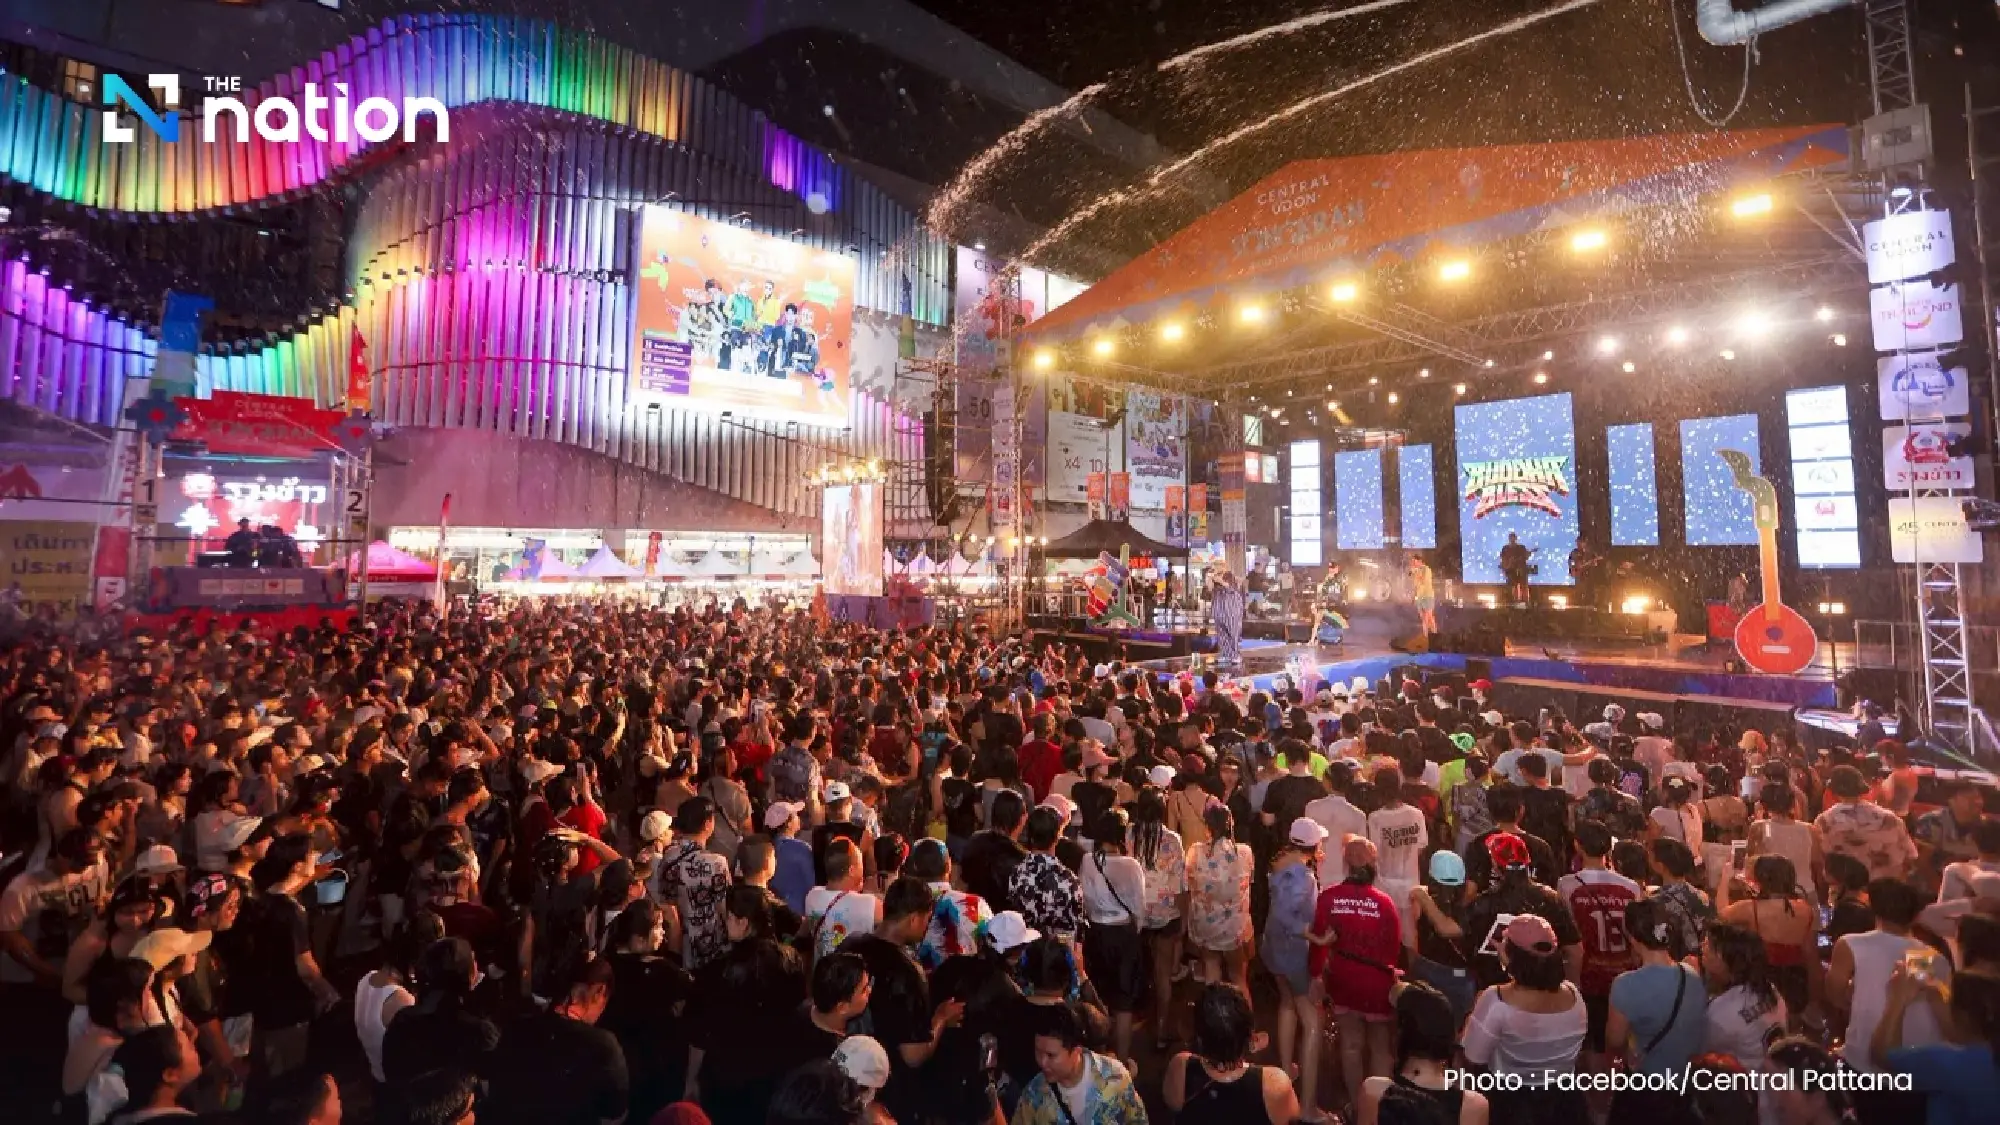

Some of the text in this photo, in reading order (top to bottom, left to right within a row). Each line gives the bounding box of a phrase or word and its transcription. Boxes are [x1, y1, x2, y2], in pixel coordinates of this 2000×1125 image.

[1257, 174, 1330, 205] CENTRAL
[1271, 192, 1316, 215] UDON
[142, 480, 156, 503] 1
[346, 491, 363, 513] 2
[1589, 910, 1627, 953] 13
